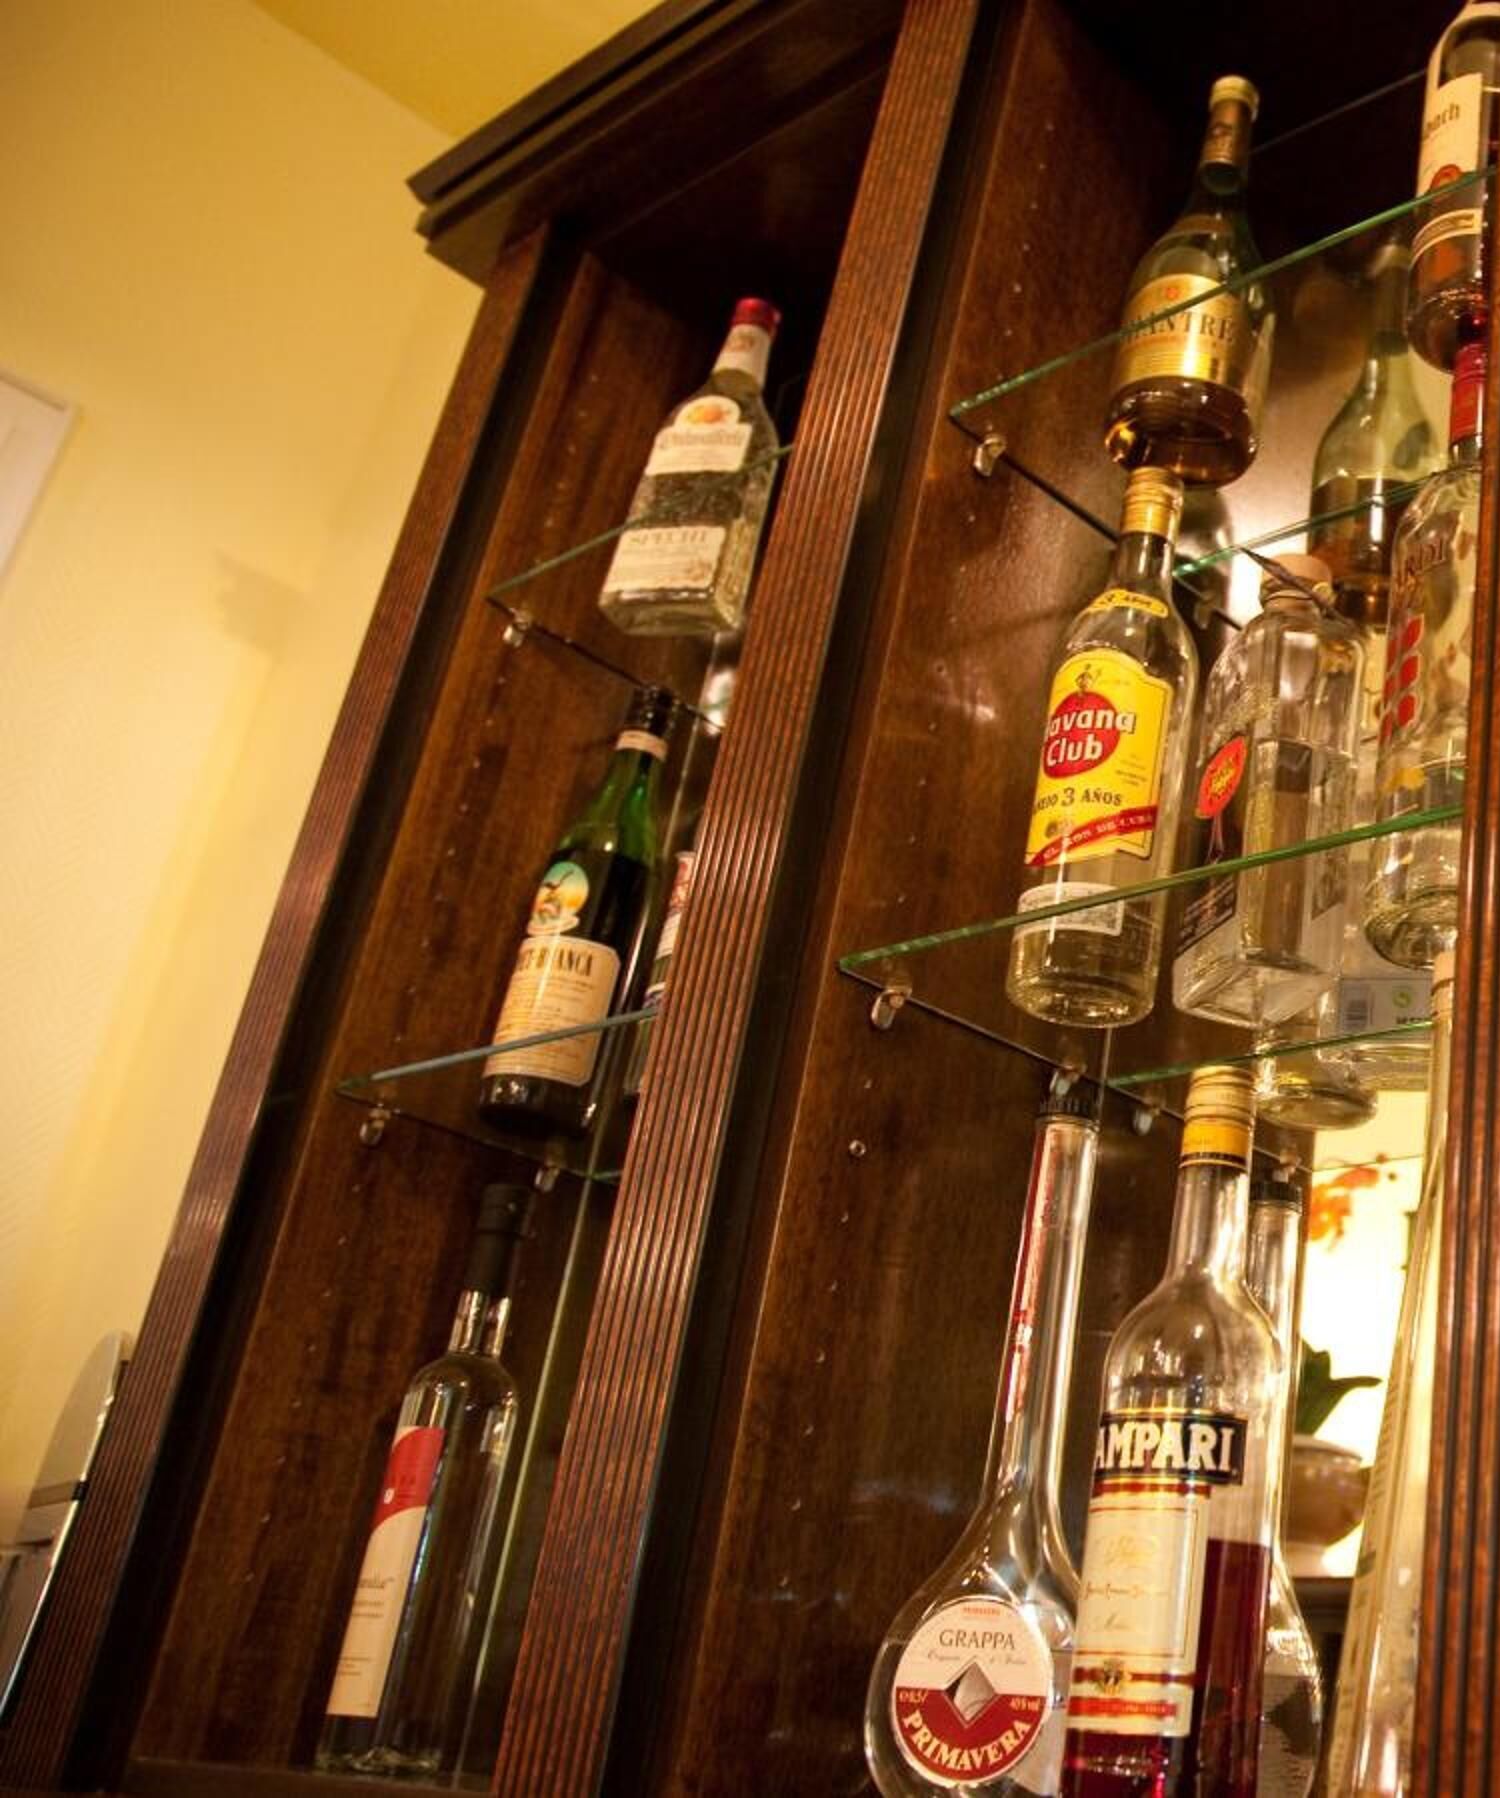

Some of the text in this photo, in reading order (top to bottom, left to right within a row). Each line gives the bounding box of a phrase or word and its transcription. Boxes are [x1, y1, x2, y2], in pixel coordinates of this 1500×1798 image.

[1046, 708, 1137, 737] avana
[1046, 732, 1104, 768] Club
[1061, 786, 1076, 807] 3
[939, 1628, 1015, 1650] GRAPPA
[902, 1709, 1032, 1771] PRIMAVERA
